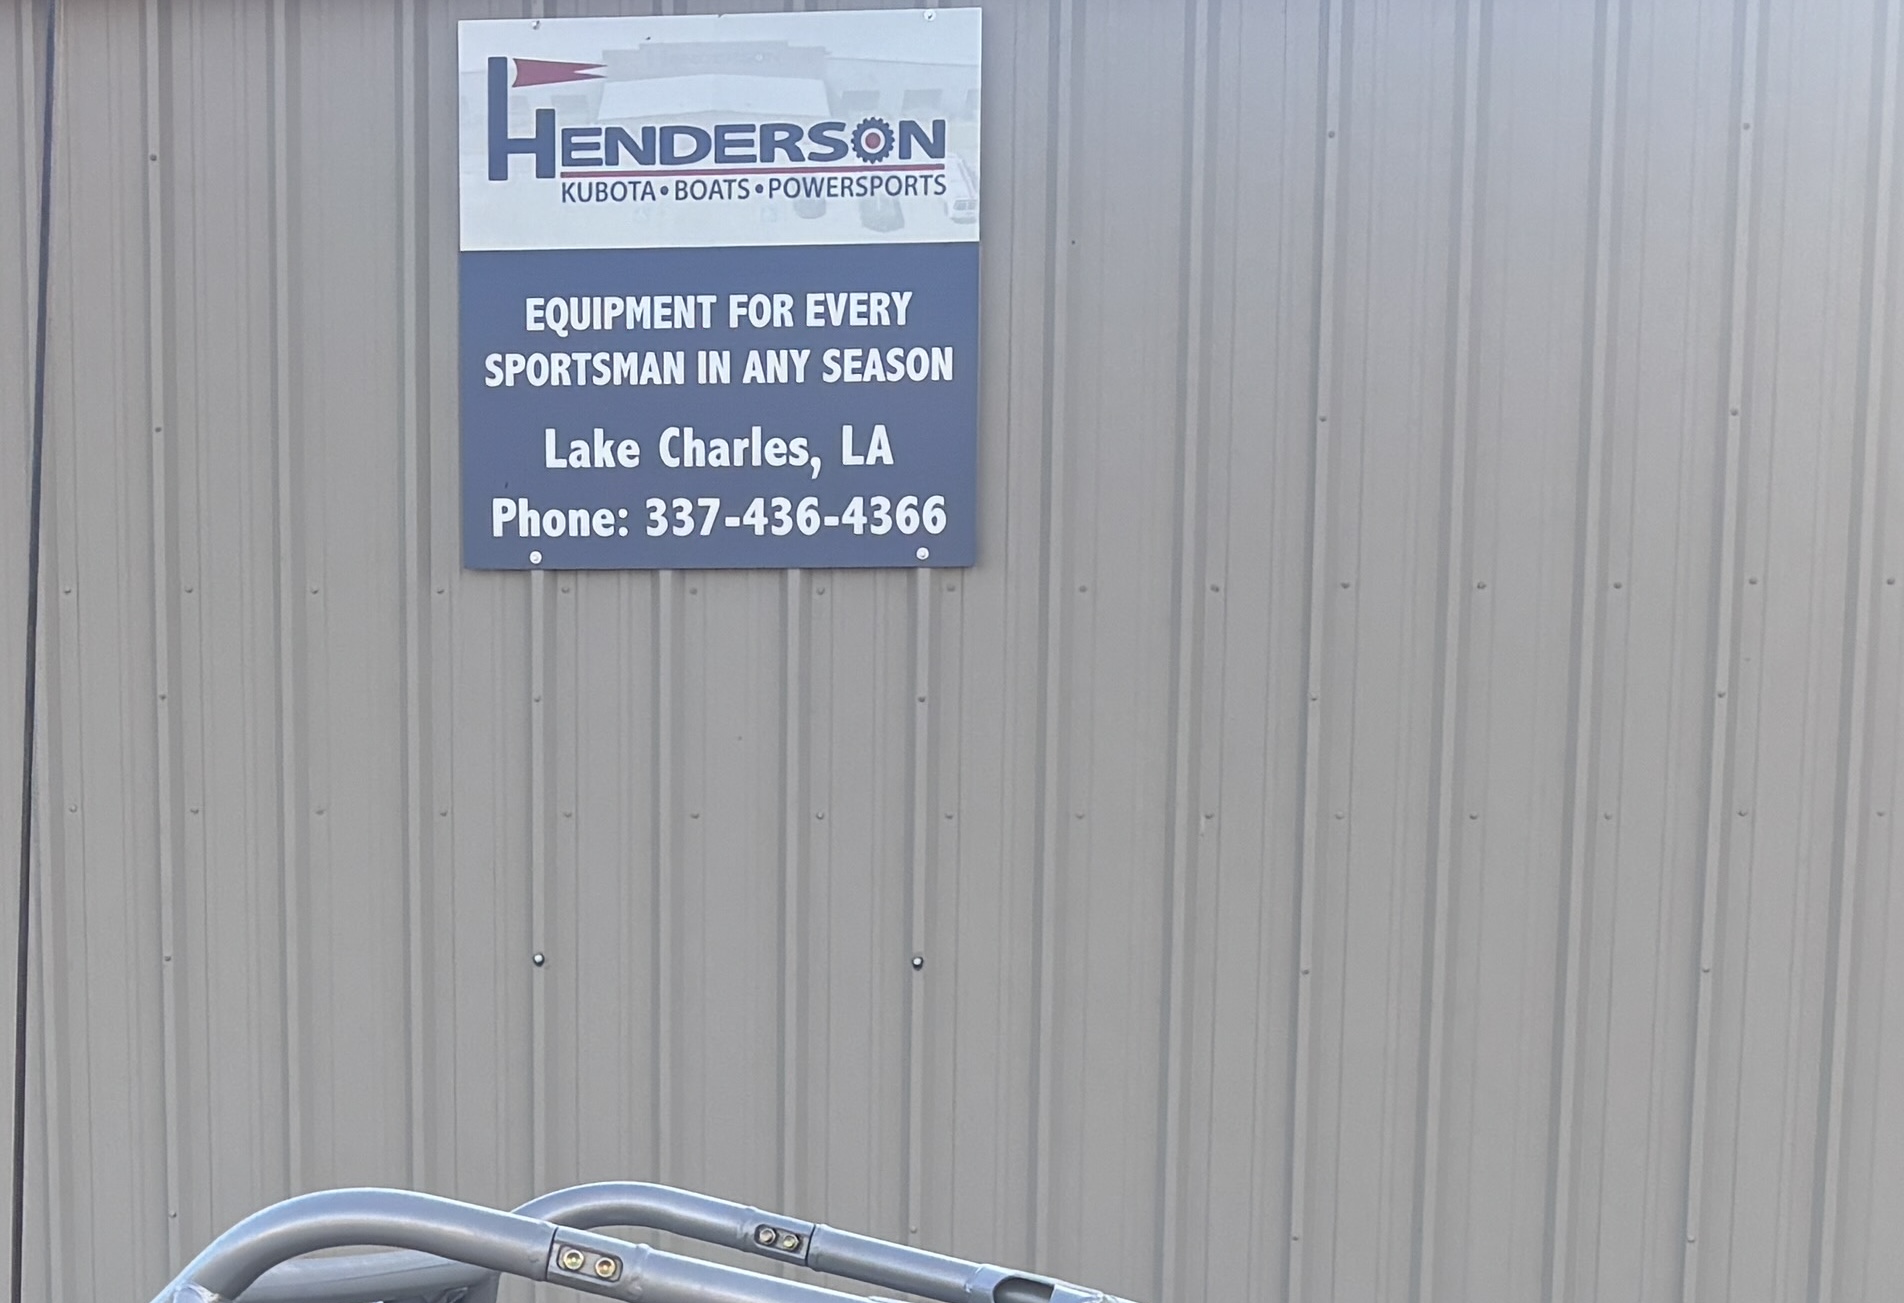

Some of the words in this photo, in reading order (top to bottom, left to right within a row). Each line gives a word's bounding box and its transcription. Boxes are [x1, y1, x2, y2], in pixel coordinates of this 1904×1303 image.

[488, 56, 946, 180] HENDERSON
[560, 180, 657, 204] KUBOTA
[674, 178, 751, 201] BOATS
[768, 174, 947, 199] POWERSPORTS
[525, 295, 717, 337] EQUIPMENT
[728, 293, 794, 328] FOR
[805, 291, 913, 327] EVERY
[484, 351, 685, 388] SPORTSMAN
[697, 350, 731, 384] IN
[742, 349, 811, 384] ANY
[821, 346, 954, 383] SEASON
[544, 427, 641, 469] Lake
[658, 425, 823, 480] Charles,
[841, 424, 894, 466] LA
[491, 497, 630, 538] Phone:
[644, 495, 947, 537] 337-436-4366
